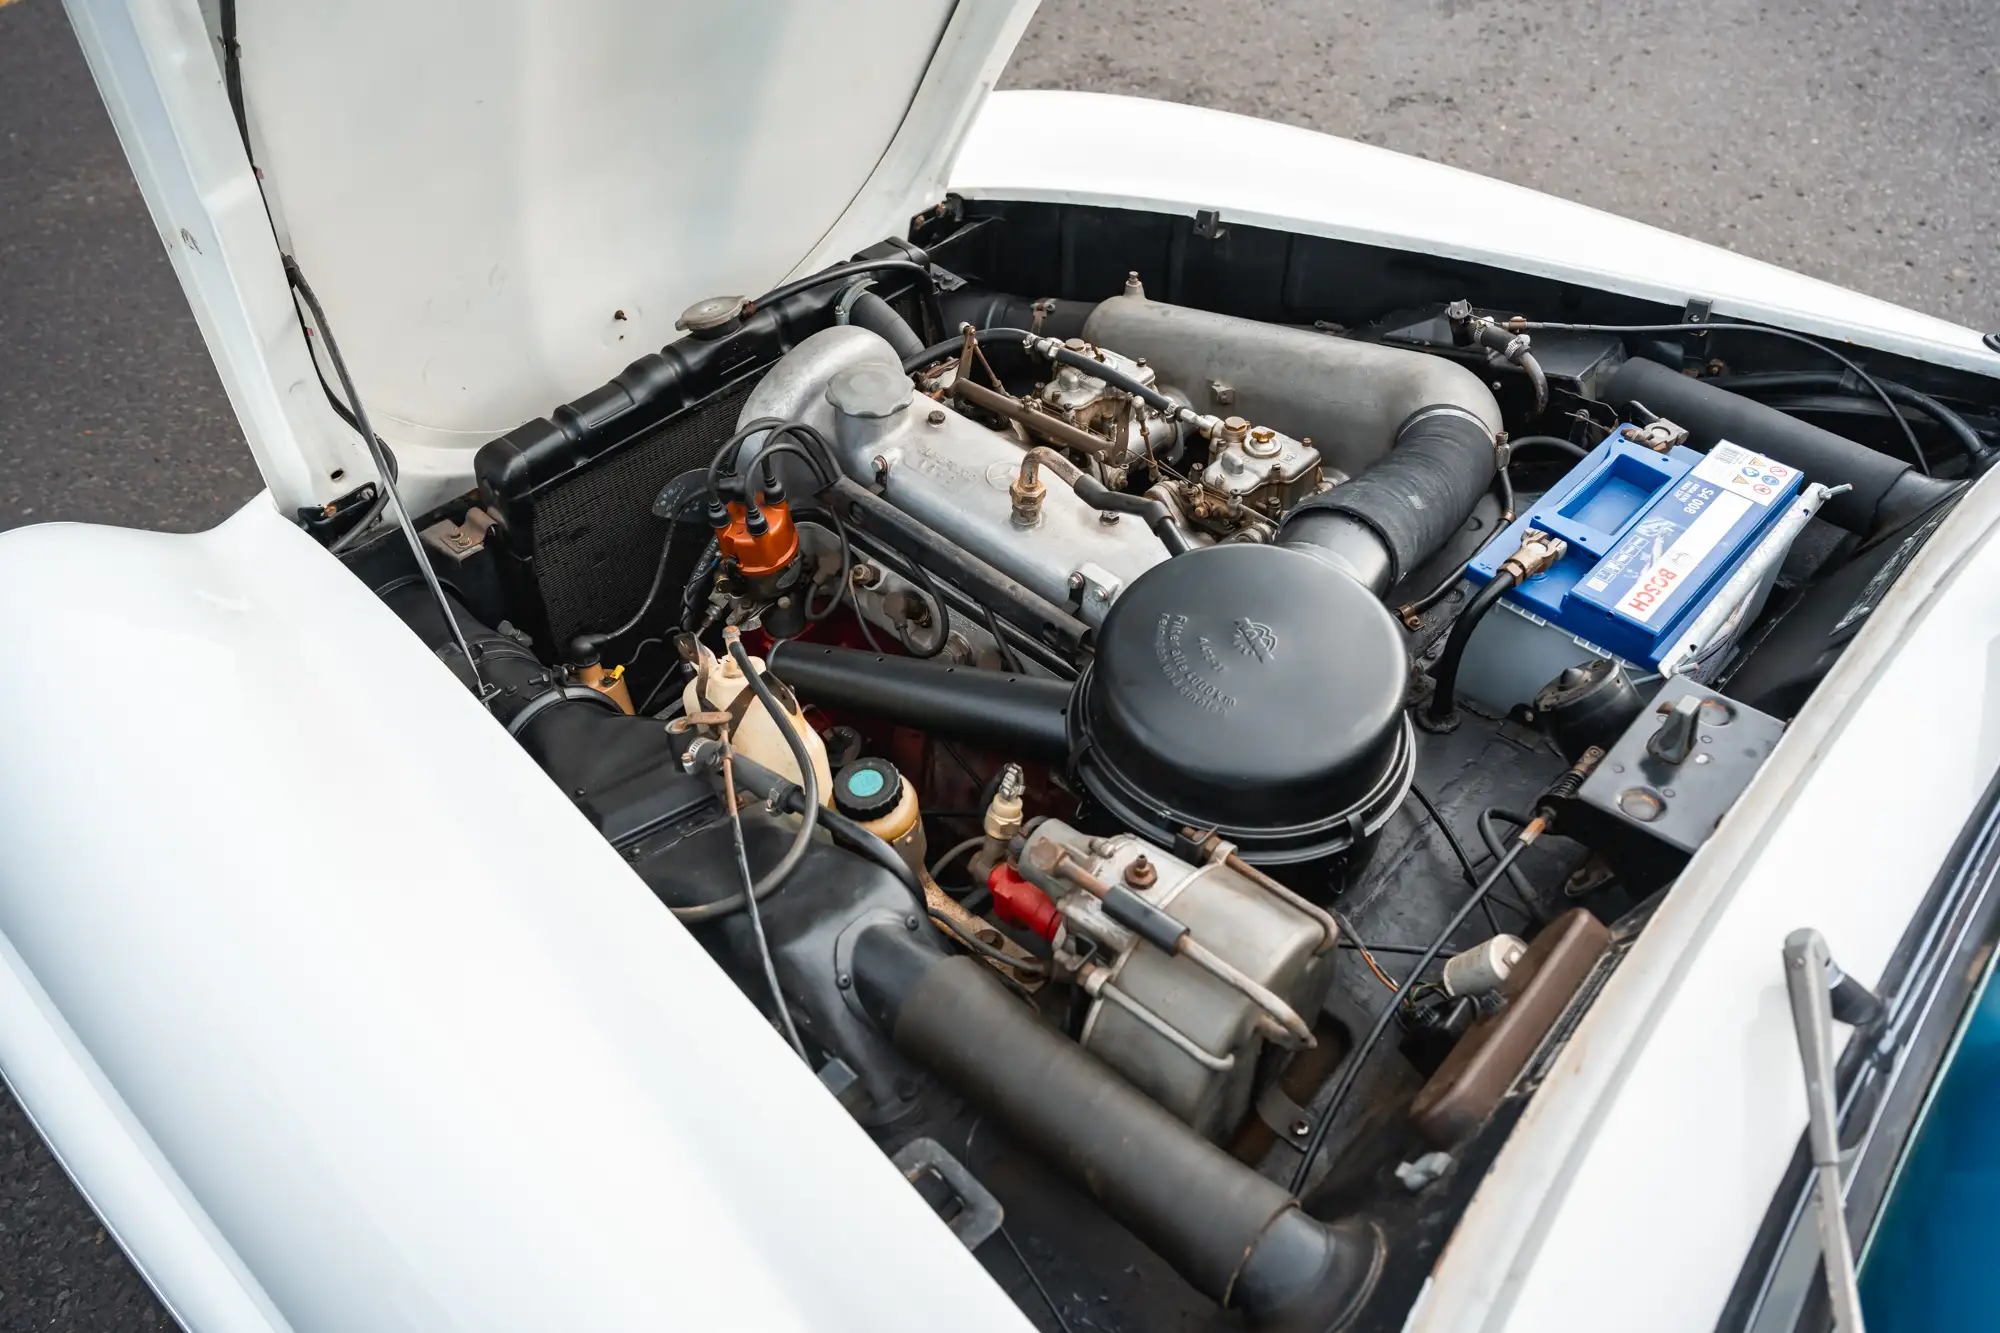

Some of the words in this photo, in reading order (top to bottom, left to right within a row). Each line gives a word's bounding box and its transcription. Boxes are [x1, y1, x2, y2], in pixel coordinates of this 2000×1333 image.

[1696, 487, 1715, 500] S4
[1683, 498, 1704, 515] 008
[1628, 568, 1678, 612] BOSCH
[1169, 614, 1189, 647] Filter
[1170, 648, 1188, 672] alle
[1162, 663, 1184, 687] und
